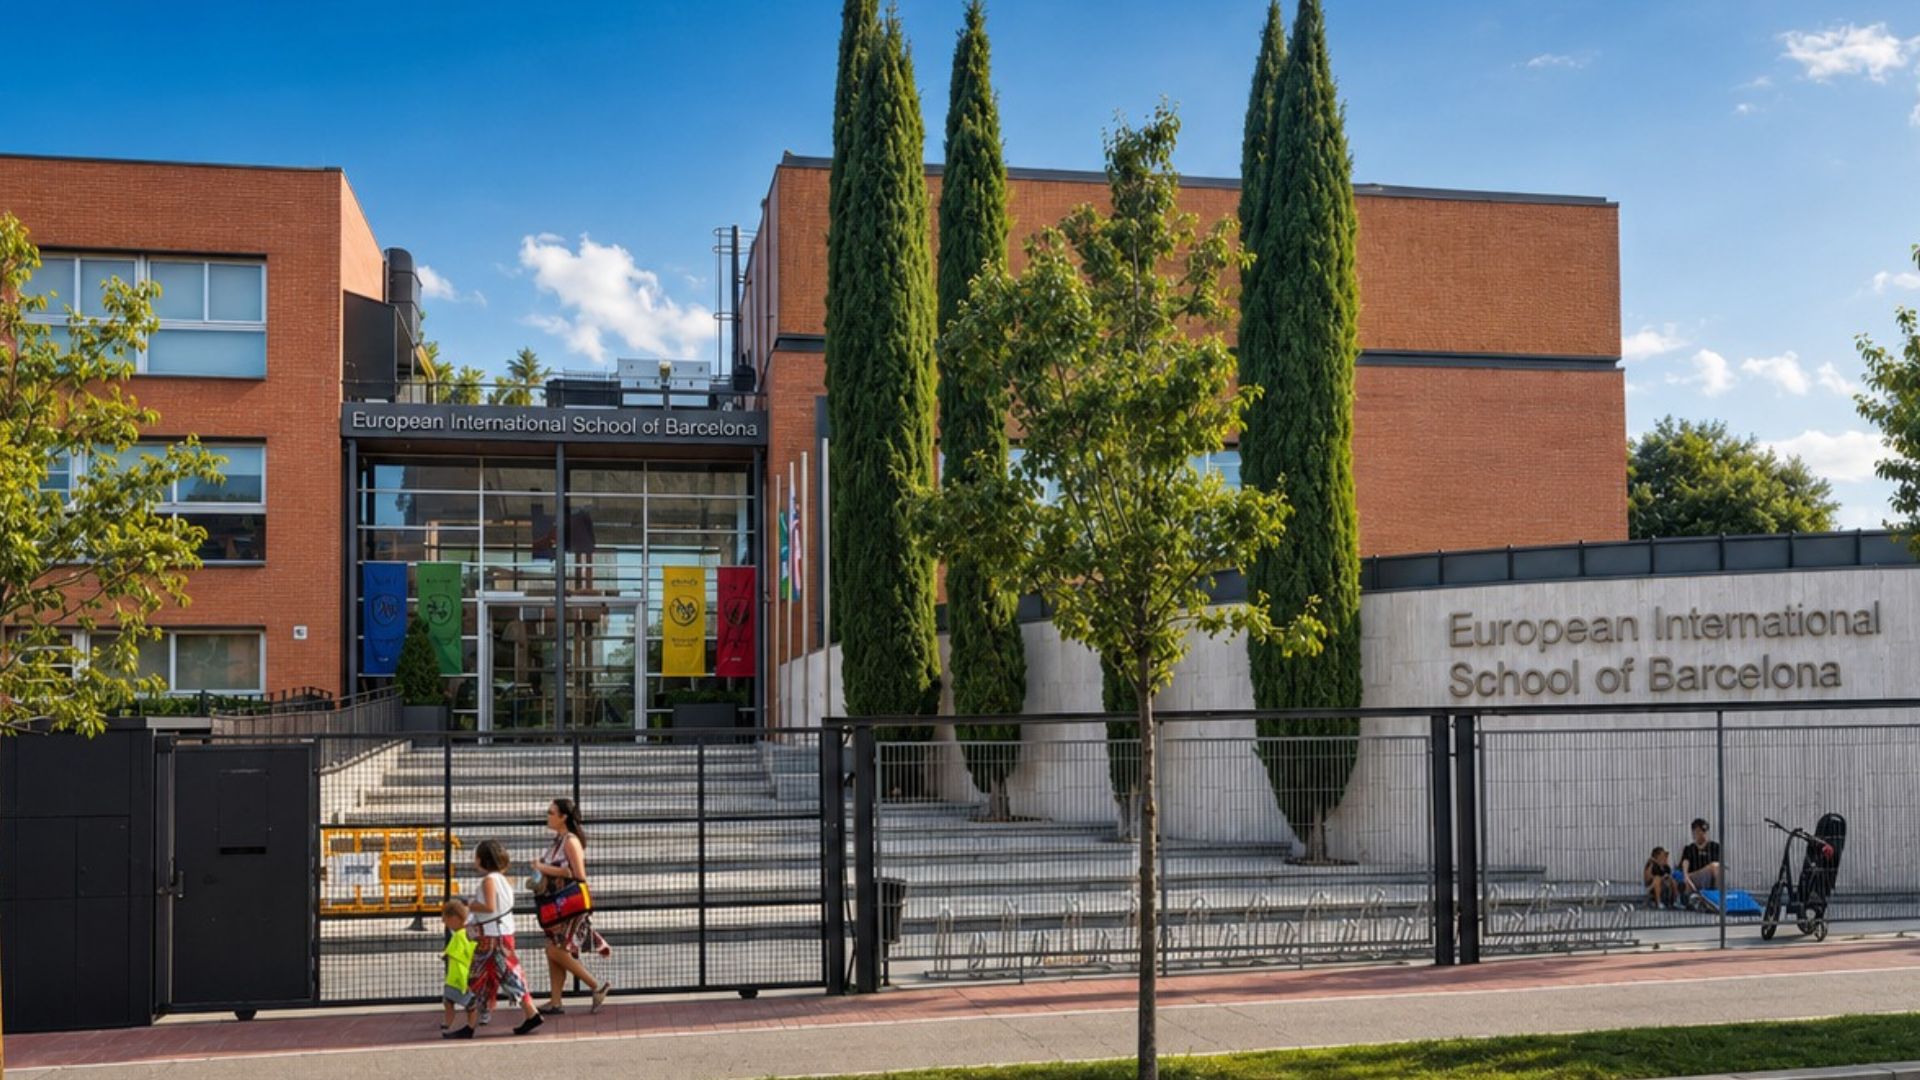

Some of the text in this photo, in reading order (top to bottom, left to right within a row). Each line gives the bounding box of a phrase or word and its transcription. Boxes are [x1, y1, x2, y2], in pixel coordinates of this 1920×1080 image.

[352, 411, 757, 436] European International School of Barcelona
[1449, 601, 1881, 653] European International
[1449, 653, 1842, 698] School of Barcelona
